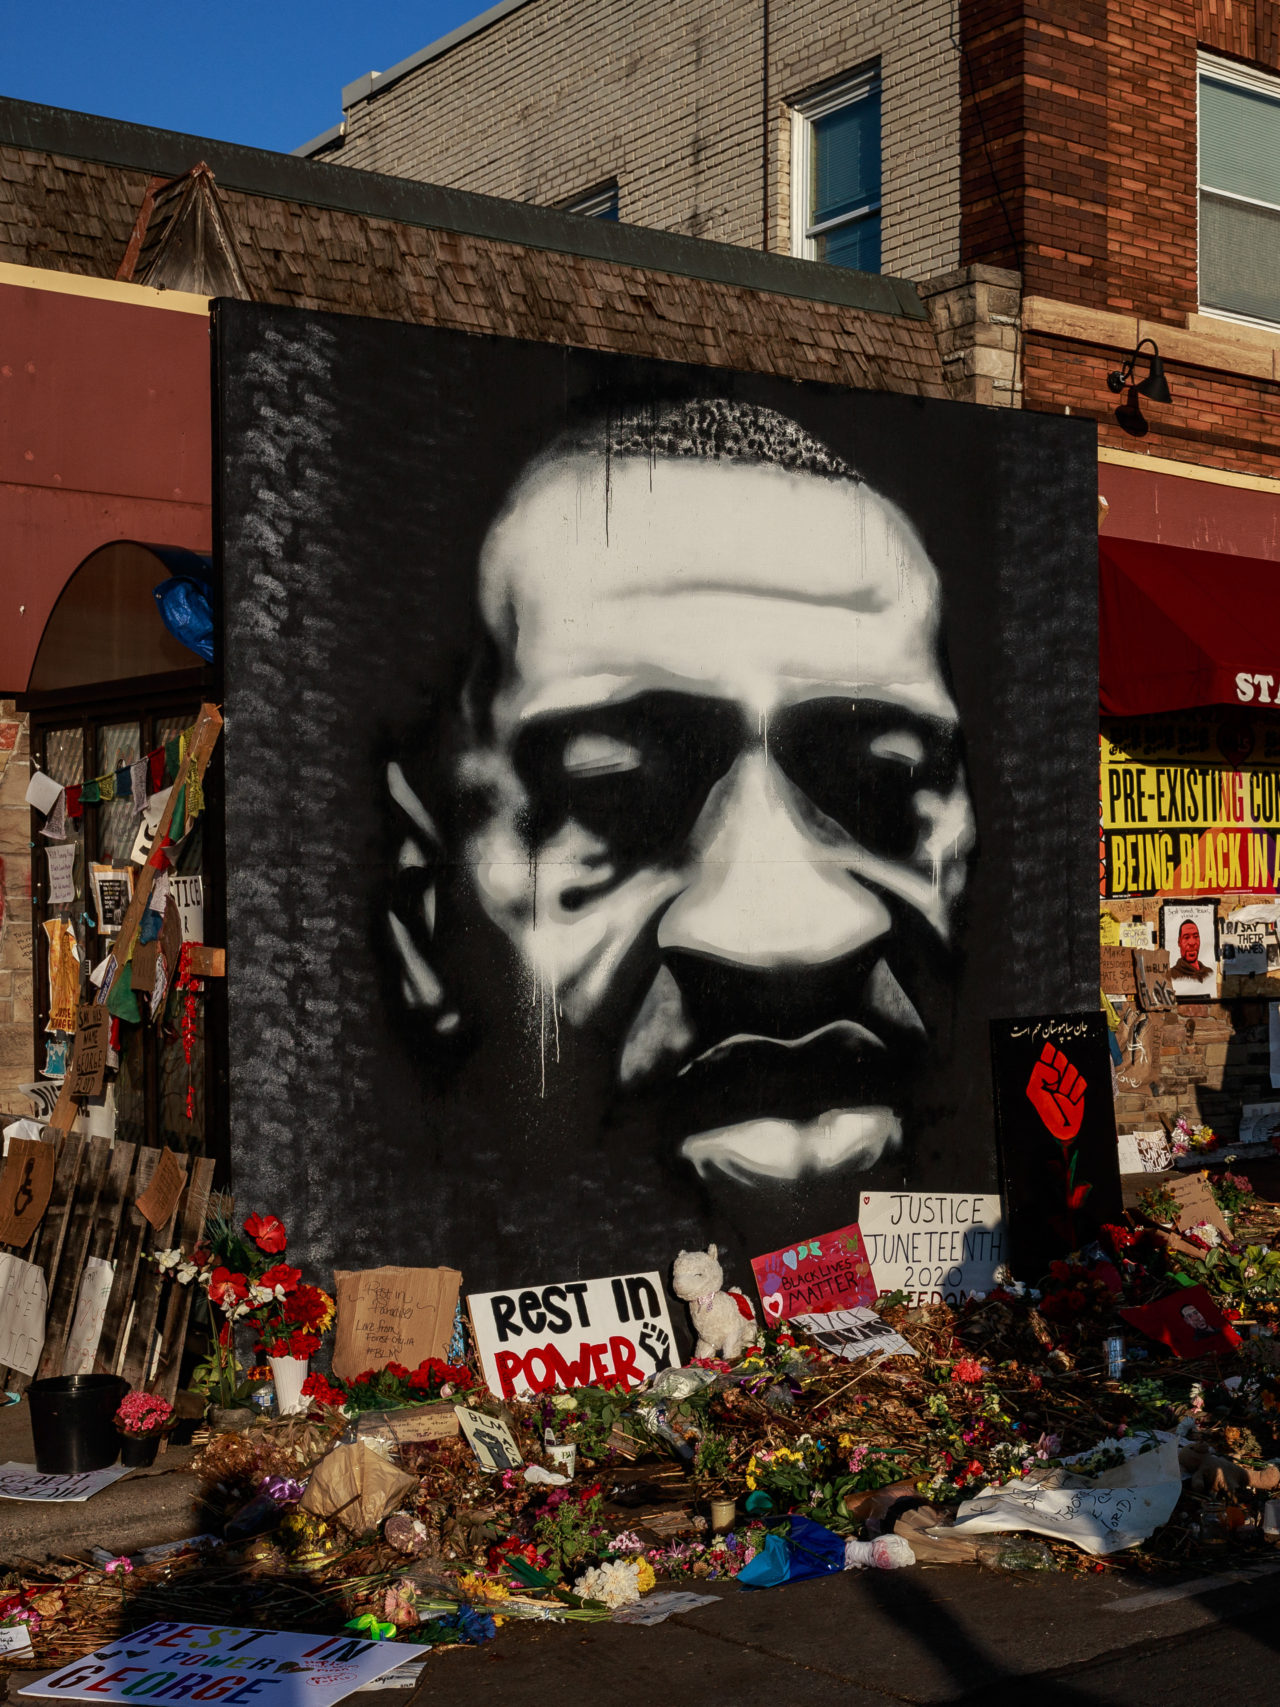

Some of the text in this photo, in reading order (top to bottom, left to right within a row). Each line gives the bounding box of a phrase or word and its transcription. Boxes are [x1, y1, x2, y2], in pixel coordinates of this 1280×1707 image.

[1108, 769, 1244, 823] PRE-EXISTING
[1111, 834, 1174, 893] BEING
[1180, 832, 1243, 890] BLACK
[1248, 833, 1268, 888] IN
[1237, 934, 1264, 944] THEIR
[1241, 923, 1258, 933] SAY
[1237, 945, 1265, 954] NAMES
[84, 1030, 98, 1043] NAME
[77, 1050, 103, 1073] GEORGE
[890, 1194, 984, 1226] JUSTICE
[863, 1231, 1002, 1266] JUNETEENTH
[781, 1259, 852, 1291] BLACK LIVES
[904, 1266, 963, 1288] 2020
[365, 1281, 393, 1300] Rest
[788, 1273, 859, 1311] MATTER
[879, 1289, 968, 1309] FEEDOM
[494, 1335, 645, 1402] POWER
[468, 1412, 507, 1435] BLM
[118, 1621, 378, 1662] REST IN
[160, 1651, 278, 1672] POWER
[47, 1664, 284, 1705] GEORGE
